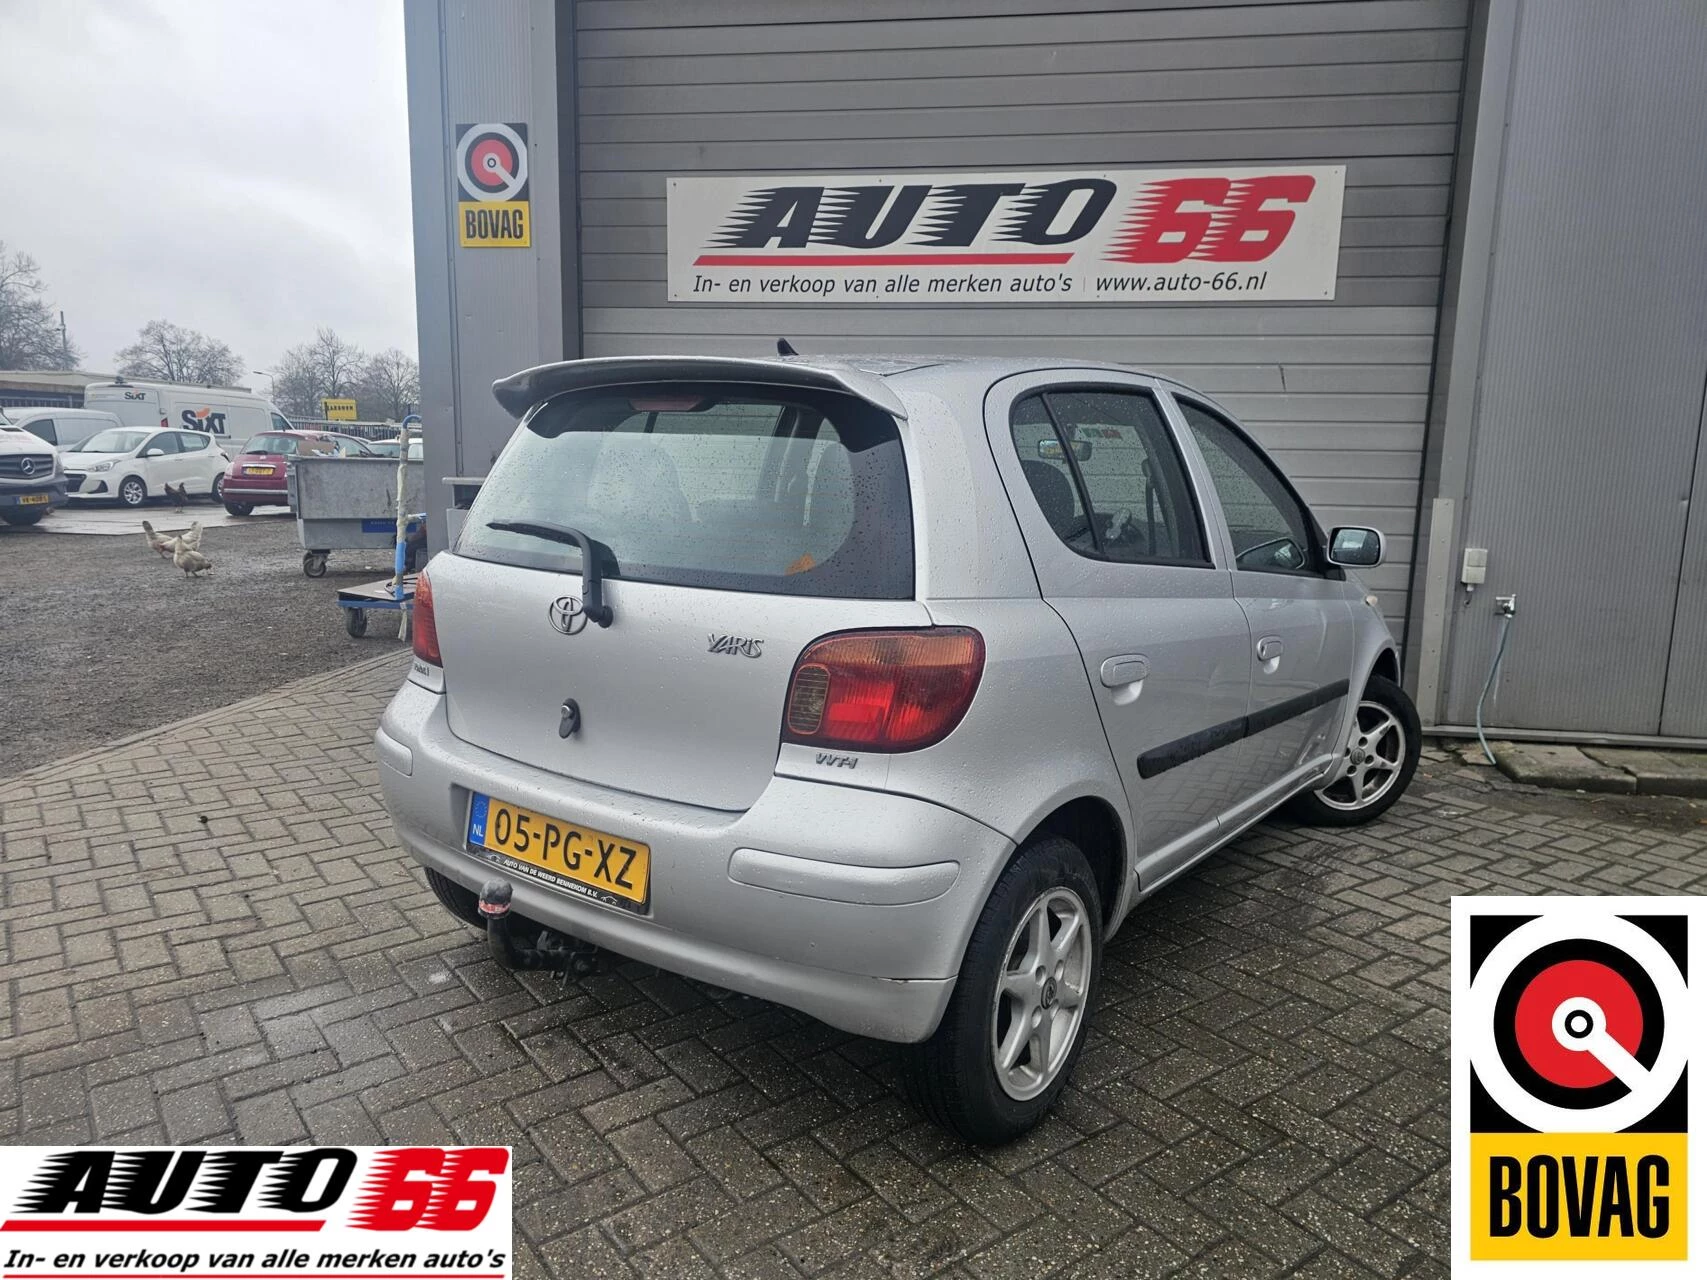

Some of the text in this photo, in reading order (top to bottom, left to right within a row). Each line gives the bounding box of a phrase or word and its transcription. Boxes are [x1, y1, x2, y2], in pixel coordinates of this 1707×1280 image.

[465, 209, 524, 239] BOVAG
[700, 175, 1316, 264] AUTO 66
[693, 273, 1073, 296] In- en verkoop van alle merken auto's
[1096, 271, 1268, 291] www.auto-66.nl
[472, 823, 484, 838] NL
[494, 808, 637, 890] 05-PG-XZ
[503, 859, 518, 869] AUTO
[518, 863, 529, 873] VAN
[529, 868, 538, 876] DE
[537, 871, 556, 882] WEERD
[556, 878, 587, 894] BENNEKOM
